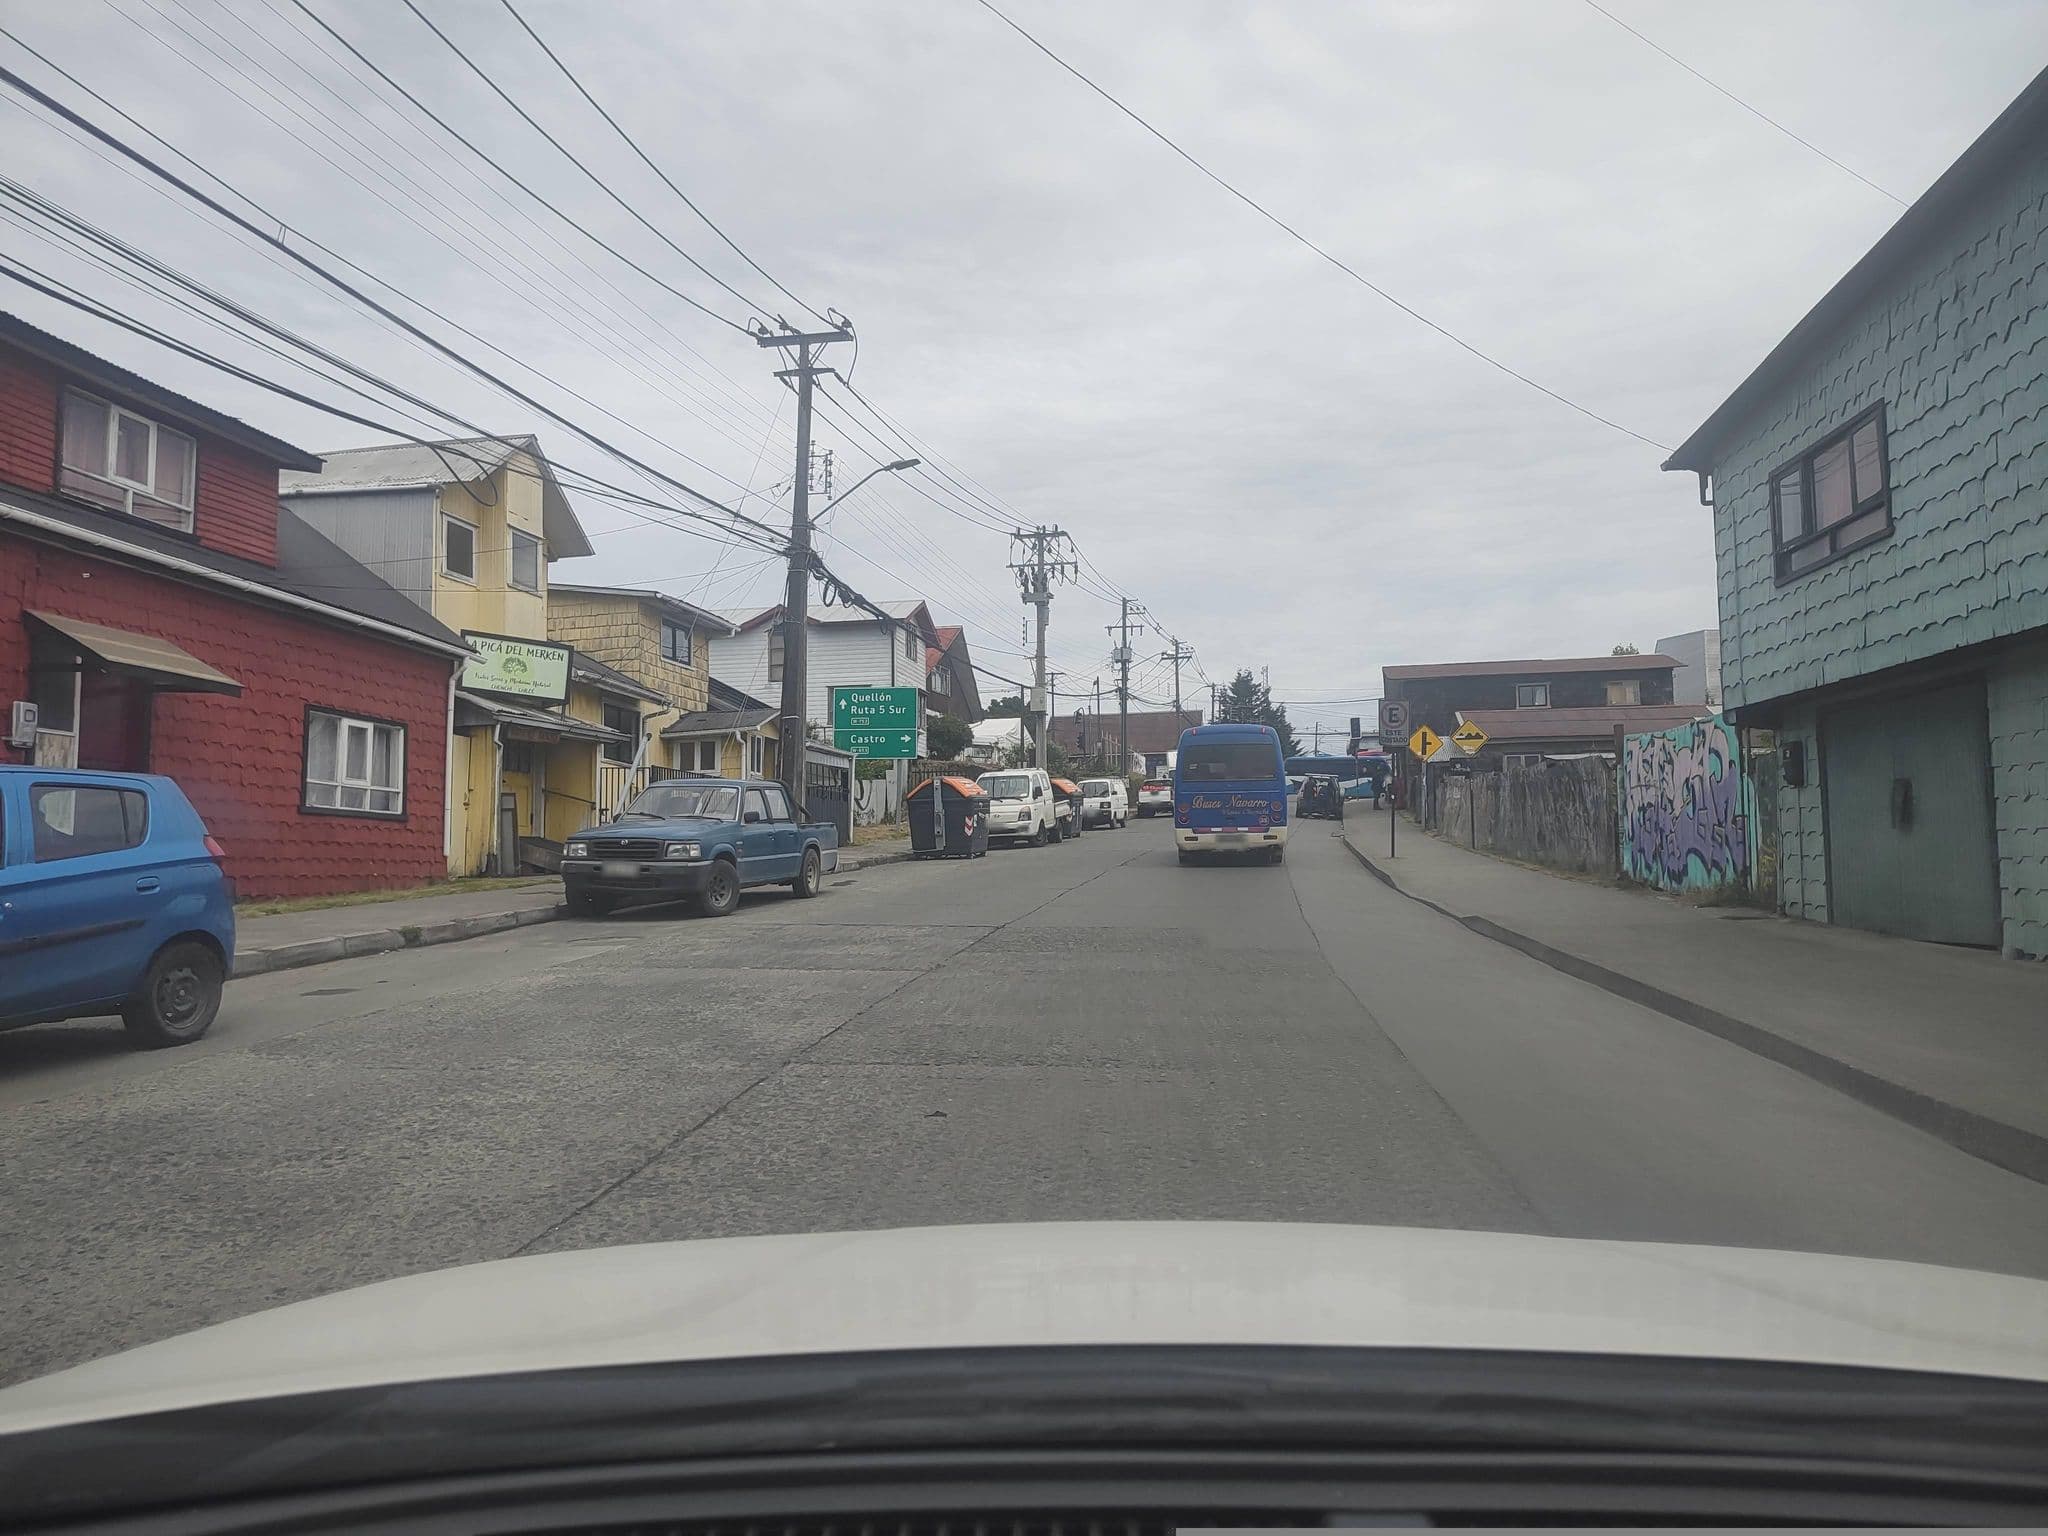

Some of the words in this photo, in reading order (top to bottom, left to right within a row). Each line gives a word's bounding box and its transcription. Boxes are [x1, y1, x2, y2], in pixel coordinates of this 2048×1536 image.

[481, 641, 503, 654] PICÁ
[505, 645, 523, 655] DEL
[527, 648, 564, 661] MERKEN
[851, 692, 892, 704] Quellón
[851, 705, 876, 715] Ruta
[879, 705, 886, 714] 5
[888, 705, 907, 714] Sur
[1389, 707, 1400, 723] E
[850, 734, 886, 744] Castro
[1192, 795, 1222, 809] Buses
[1226, 794, 1269, 809] Navarro
